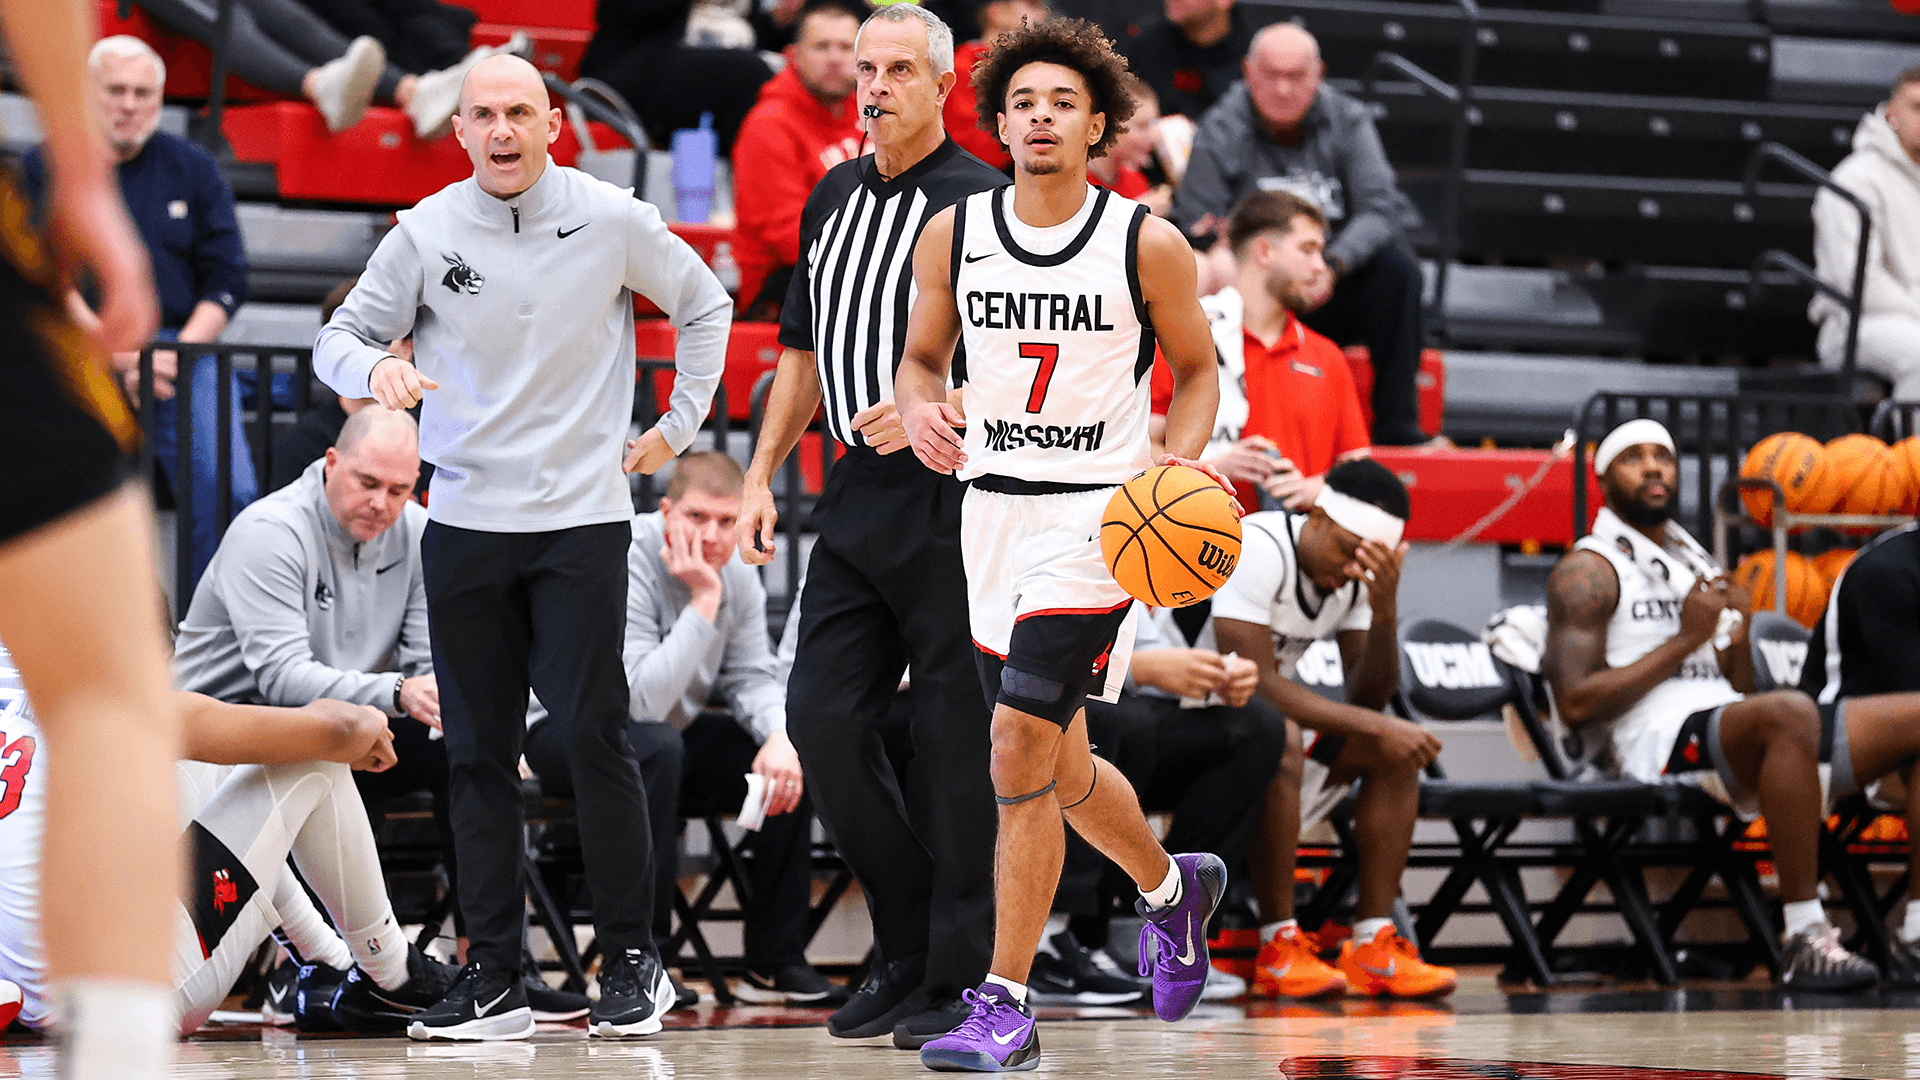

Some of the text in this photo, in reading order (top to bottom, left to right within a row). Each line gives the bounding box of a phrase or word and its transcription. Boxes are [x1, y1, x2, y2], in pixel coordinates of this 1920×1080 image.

[966, 290, 1114, 332] CENTRAL
[1018, 342, 1059, 414] 7
[983, 418, 1106, 452] MISSOURI
[1296, 639, 1344, 687] UC
[1404, 641, 1504, 688] UCM
[1757, 639, 1809, 686] UC
[0, 731, 36, 820] 3
